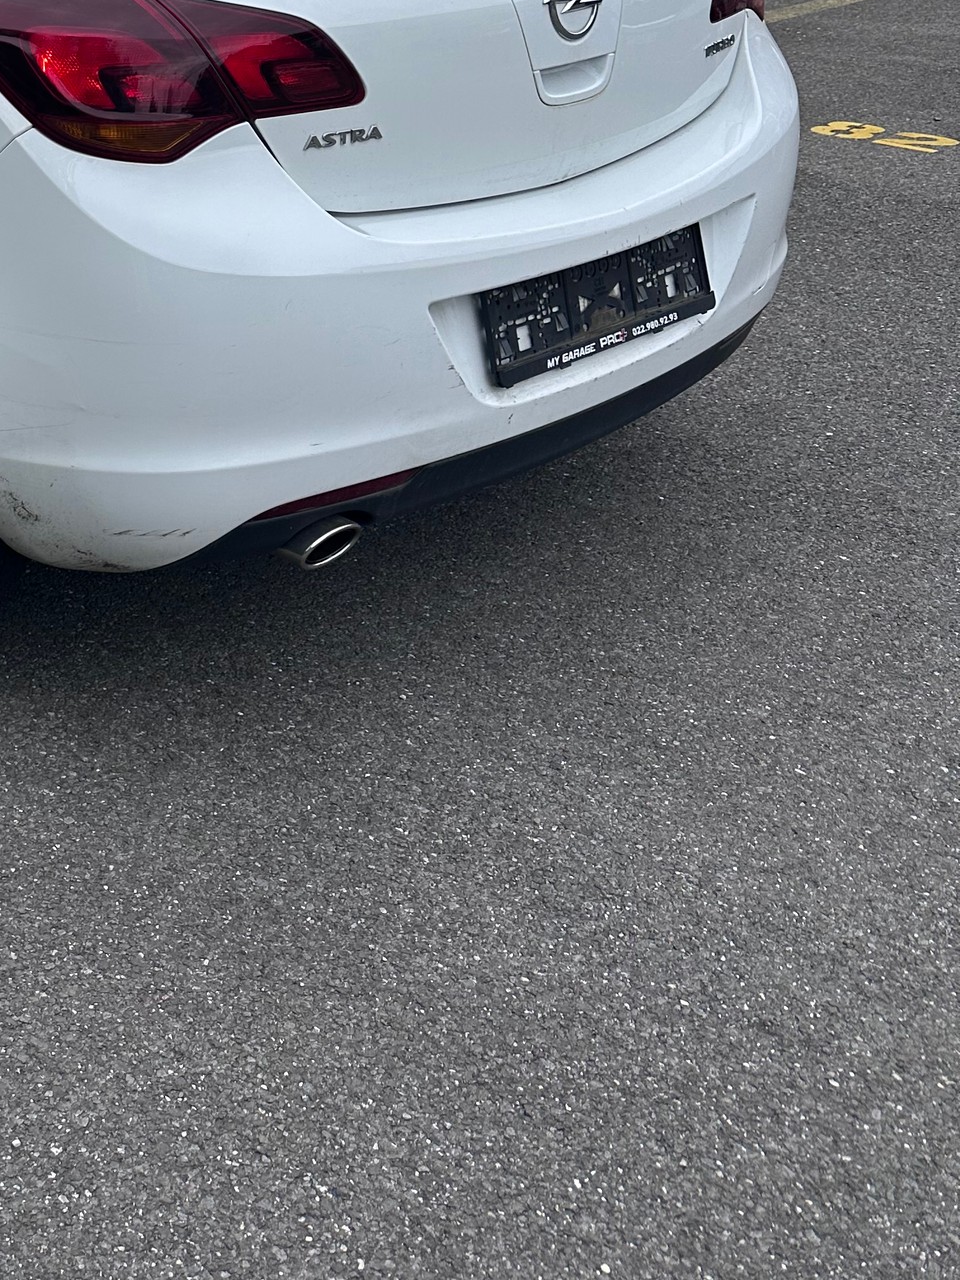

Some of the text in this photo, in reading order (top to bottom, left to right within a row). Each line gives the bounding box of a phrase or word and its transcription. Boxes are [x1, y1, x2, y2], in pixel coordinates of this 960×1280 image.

[303, 124, 383, 151] ASTRA
[547, 356, 560, 369] MY
[561, 342, 596, 363] GARAGE
[632, 312, 678, 337] 022.980.92.93
